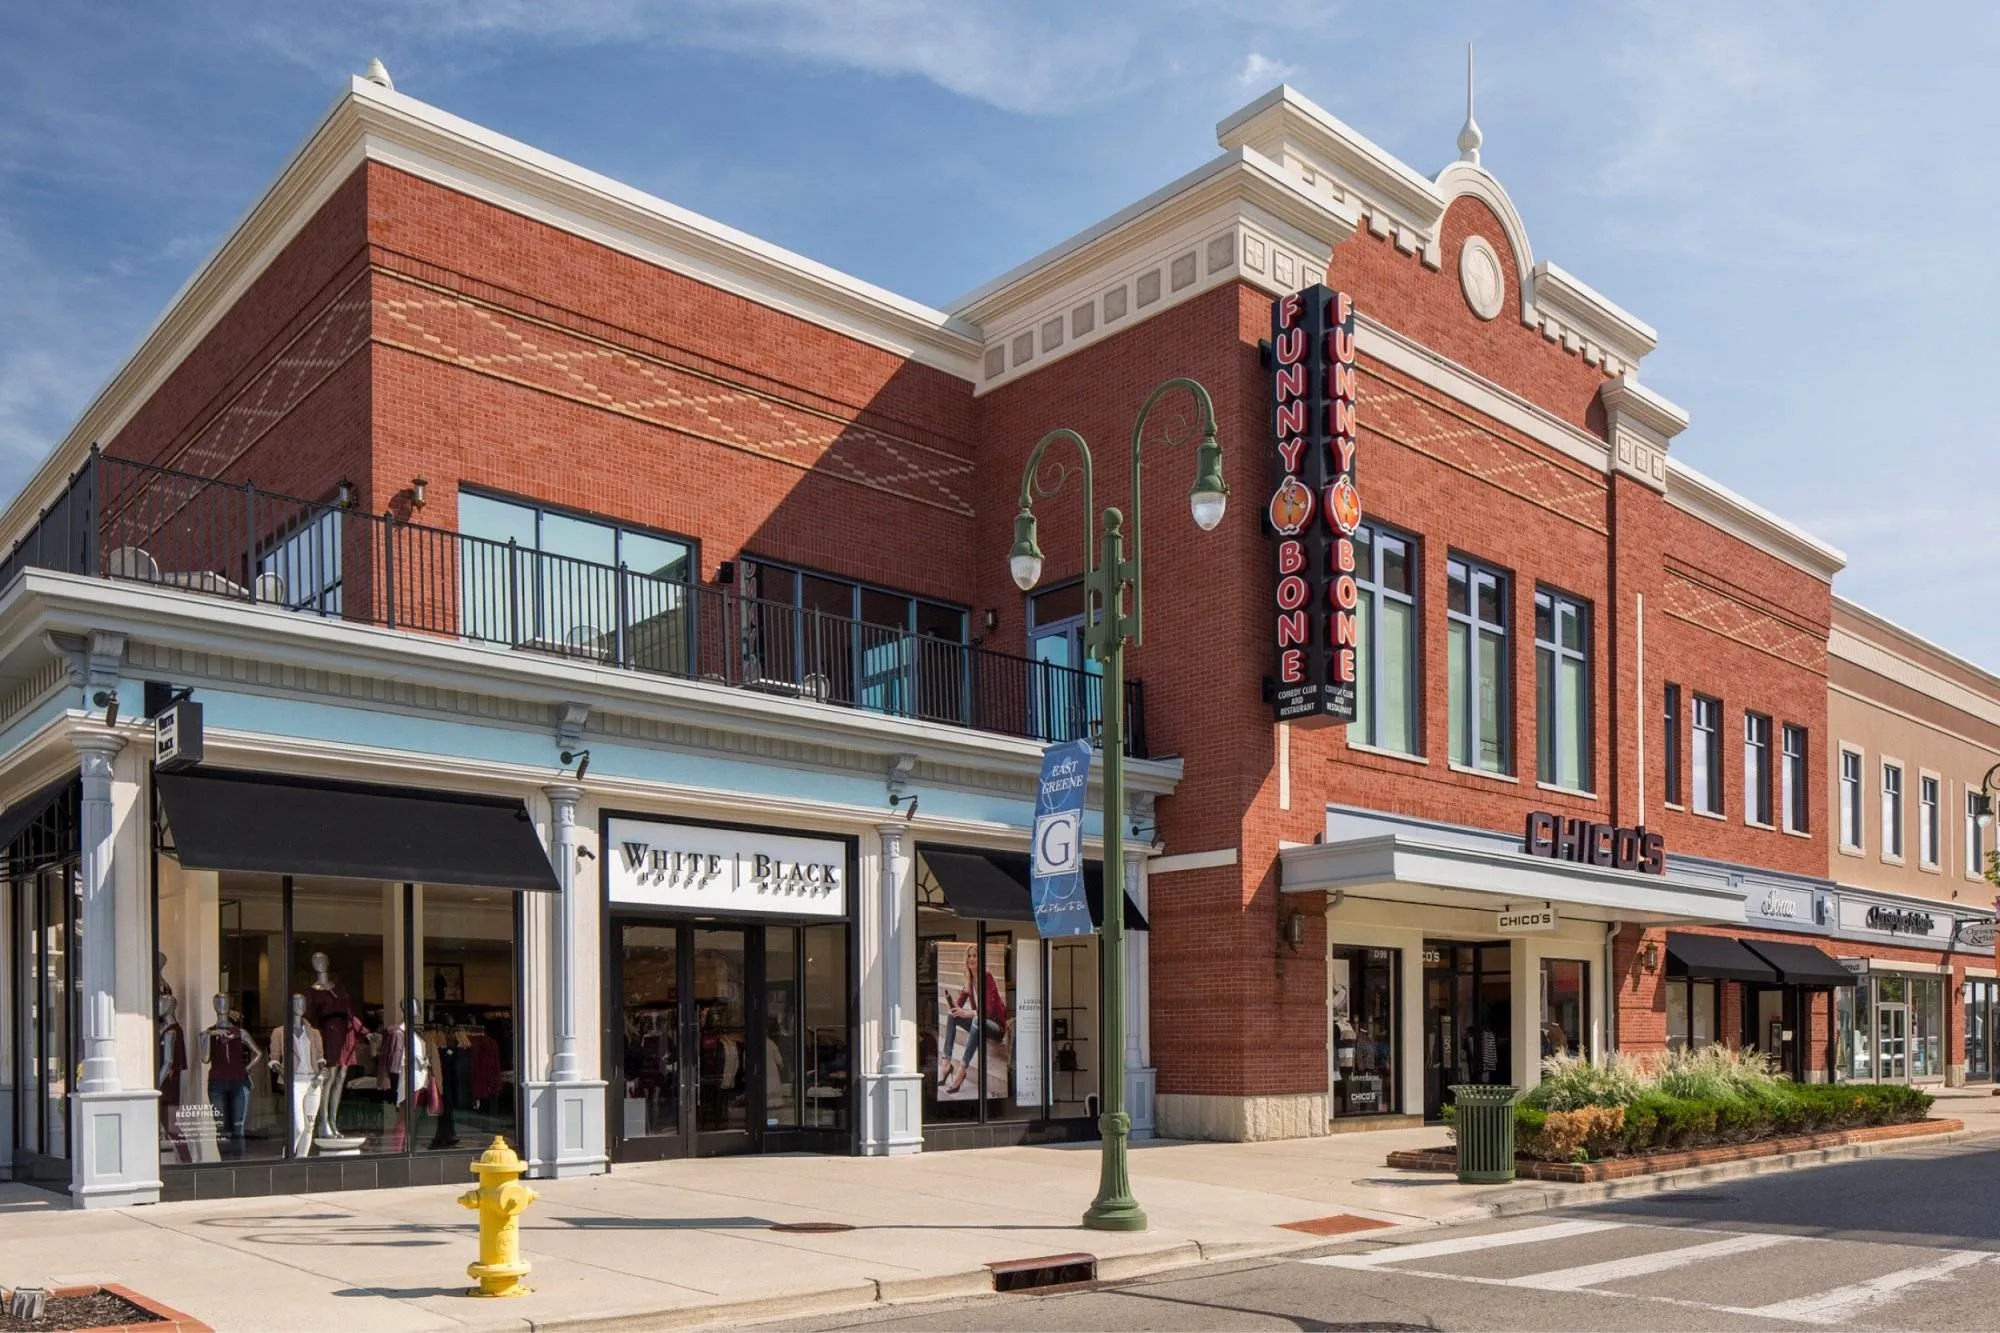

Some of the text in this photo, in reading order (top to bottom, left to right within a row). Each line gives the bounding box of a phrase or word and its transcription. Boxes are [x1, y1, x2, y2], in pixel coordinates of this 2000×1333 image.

[1277, 293, 1303, 473] FUNNY
[1336, 291, 1356, 472] FUNNY
[1277, 540, 1305, 683] BONE
[1336, 538, 1358, 682] BONE
[1042, 774, 1084, 794] GREENE
[1052, 760, 1079, 777] EAST
[622, 842, 837, 884] WHITE BLACK
[1041, 819, 1072, 866] G
[1525, 811, 1666, 877] CHICO'S
[641, 872, 833, 895] HOUSE MARKET
[1500, 912, 1551, 928] CHICO'S
[175, 1110, 224, 1118] REDEFINED.
[182, 1103, 217, 1111] LUXURY.
